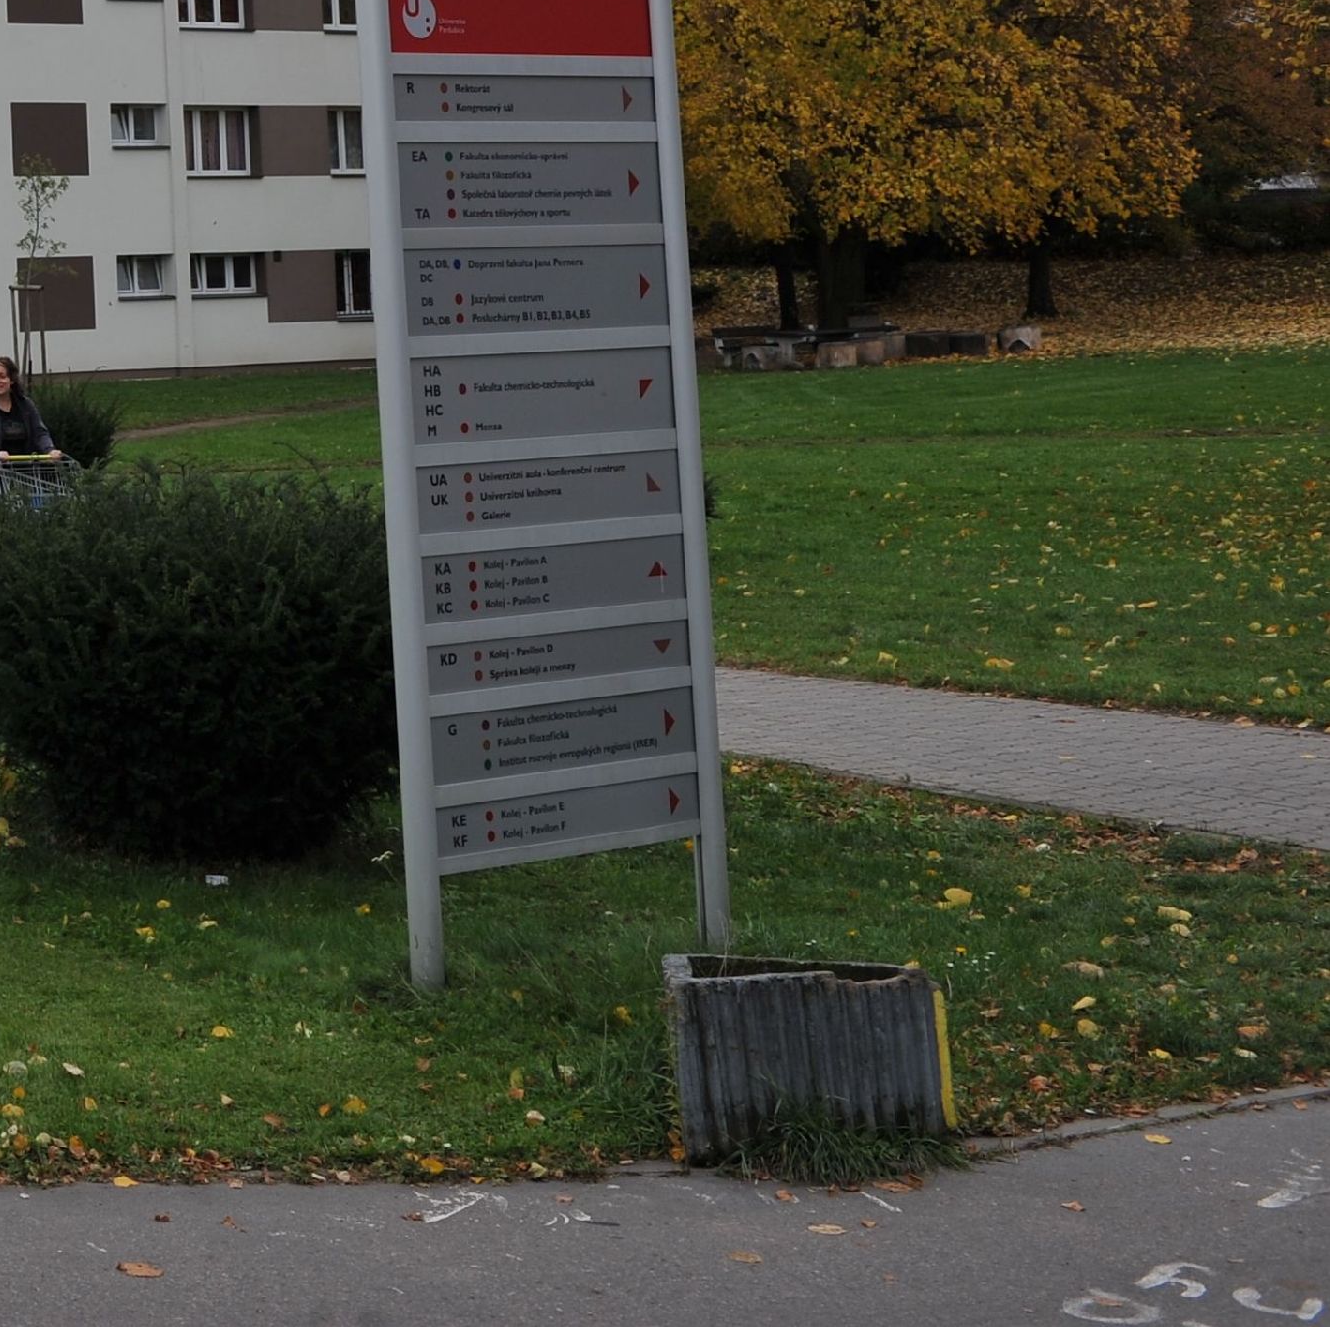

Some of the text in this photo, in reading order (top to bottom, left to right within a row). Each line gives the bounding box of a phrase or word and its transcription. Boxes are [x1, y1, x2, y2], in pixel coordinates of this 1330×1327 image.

[406, 81, 491, 94] R Rektorát
[412, 150, 428, 162] EA
[459, 151, 490, 161] Fakulta
[460, 170, 490, 180] Fakulta
[414, 208, 431, 220] TA
[462, 208, 493, 218] Katedra
[546, 209, 571, 218] sportu
[420, 273, 433, 283] DC
[421, 296, 434, 307] DB
[508, 294, 544, 304] centrum
[423, 365, 442, 377] HA
[424, 384, 441, 397] HB
[473, 381, 503, 392] Fakulta
[425, 403, 444, 417] HC
[428, 424, 437, 437] M
[430, 473, 448, 487] UA
[431, 493, 448, 507] UK
[481, 509, 511, 521] Galerie
[435, 562, 452, 576] KA
[483, 559, 504, 571] Kolej
[510, 557, 539, 568] Pavilon
[540, 556, 547, 565] A
[435, 582, 452, 595] KB
[484, 578, 505, 590] Kolej
[511, 575, 540, 587] Pavilon
[541, 575, 549, 585] B
[436, 601, 453, 615] KC
[485, 597, 506, 609] Kolej
[512, 594, 541, 606] Pavilon
[542, 592, 550, 603] C
[440, 652, 458, 667] KD
[489, 648, 509, 660] Kolej
[516, 645, 545, 657] Pavilon
[547, 644, 554, 654] D
[489, 668, 518, 681] Správa
[448, 723, 458, 736] G
[497, 716, 525, 729] Fakulta
[497, 736, 527, 748] Fakulta
[452, 814, 467, 828] KE
[501, 808, 521, 819] Kolej
[528, 803, 557, 816] Pavilon
[558, 801, 565, 811] E
[453, 834, 468, 848] KF
[503, 827, 523, 840] Kolej
[530, 822, 559, 835] Pavilon
[561, 820, 566, 831] F
